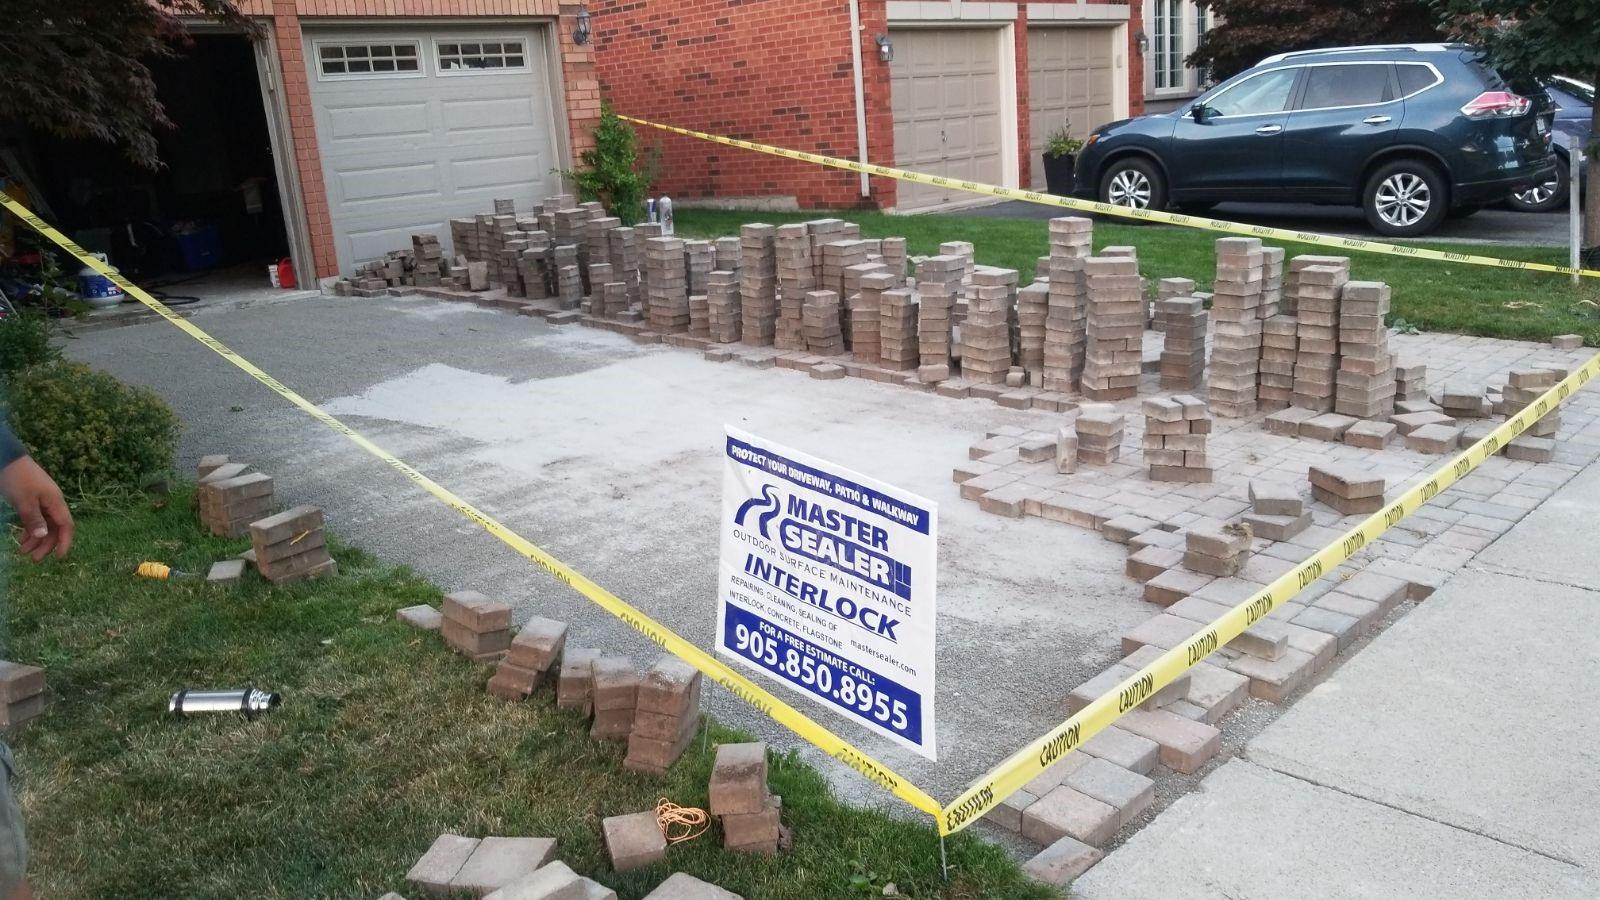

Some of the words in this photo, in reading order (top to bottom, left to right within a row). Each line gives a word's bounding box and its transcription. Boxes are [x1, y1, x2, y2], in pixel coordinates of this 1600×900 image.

[1343, 239, 1368, 248] CAUTION
[1391, 245, 1418, 255] CAUTION
[1443, 251, 1471, 261] CAUTION
[732, 446, 767, 467] PROTECT
[768, 458, 787, 475] YOUR
[788, 466, 833, 493] DRIVEWAY,
[835, 484, 860, 502] PATIO
[862, 493, 870, 505] &
[872, 498, 918, 525] WALKWAY
[785, 521, 891, 585] SEALER
[787, 494, 889, 552] MASTER
[733, 529, 777, 557] OUTDOOR
[779, 551, 825, 579] SURFACE
[830, 572, 912, 617] MAINTENANCE
[744, 553, 900, 641] INTERLOCK
[766, 591, 798, 615] CLEANING,
[798, 609, 827, 627] SEALING
[828, 621, 838, 632] OF
[767, 606, 802, 632] CONCRETE,
[802, 625, 844, 650] FLAGSTONE
[1039, 722, 1081, 768] CAUTION
[1118, 672, 1154, 714] CAUTION
[1188, 629, 1218, 667] CAUTION
[1246, 593, 1273, 626] CAUTION
[1298, 559, 1322, 591] CAUTION
[1343, 529, 1365, 558] CAUTION
[1384, 503, 1404, 528] CAUTION
[1420, 478, 1439, 503] CAUTION
[1453, 456, 1470, 480] CAUTION
[735, 623, 908, 730] 905.850.8955
[760, 621, 776, 637] FOR
[777, 630, 784, 641] A
[784, 633, 804, 652] FREE
[805, 644, 848, 673] ESTIMATE
[849, 665, 875, 686] CALL:
[850, 638, 917, 677] mastersealer.com
